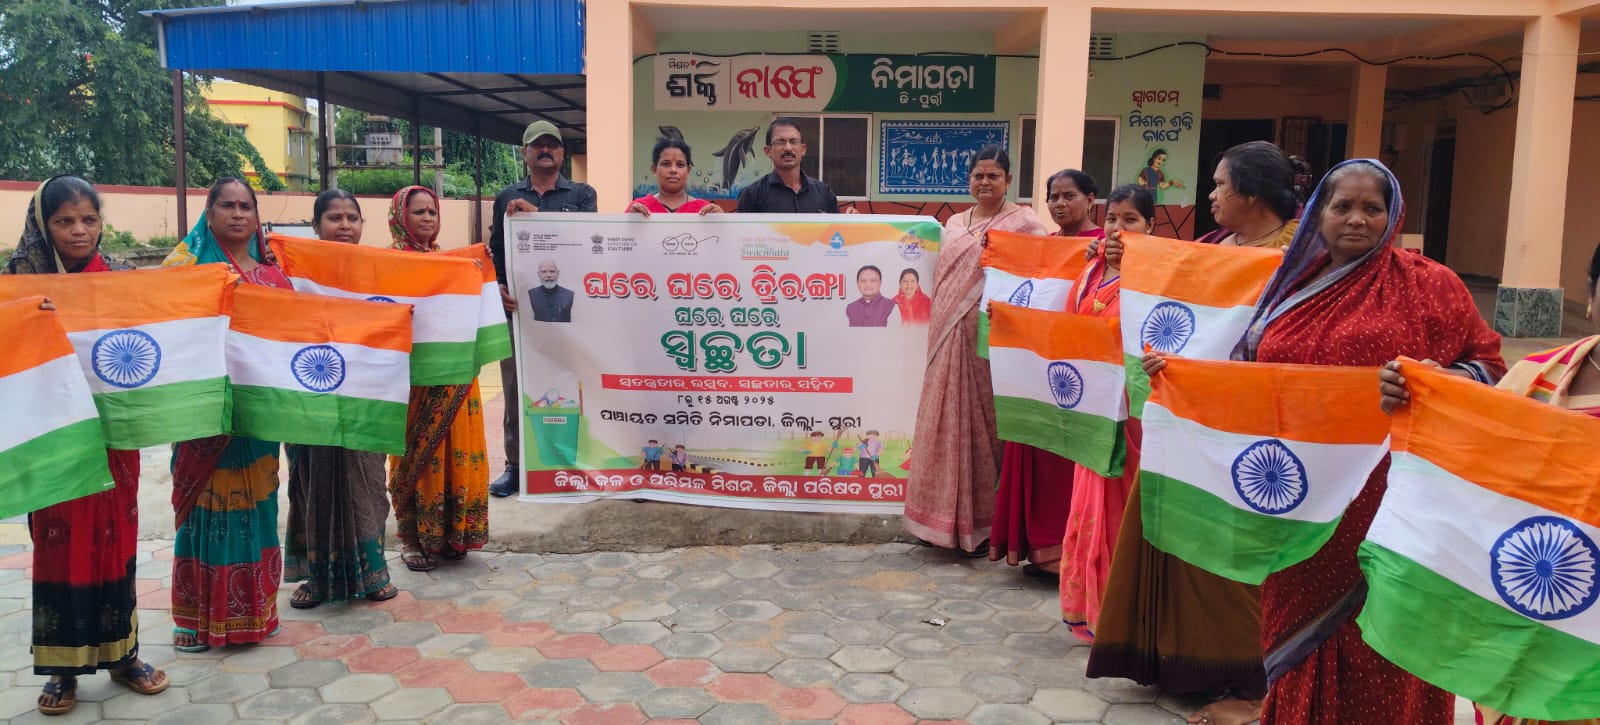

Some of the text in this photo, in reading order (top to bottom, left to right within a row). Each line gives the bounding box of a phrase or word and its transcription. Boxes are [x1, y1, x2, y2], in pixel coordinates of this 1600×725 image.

[668, 58, 690, 69] ମିଶନ
[736, 65, 823, 99] କାଫେ
[871, 57, 974, 93] ନିମାପଡ଼ା
[899, 91, 909, 104] ଜି
[919, 91, 942, 108] ପୁରୀ
[1132, 90, 1180, 109] ସ୍ୱାଗତମ୍
[1129, 110, 1193, 130] ମିଶନ ଶକ୍ତି
[583, 264, 846, 304] ଘରେ ଘରେ ତ୍ରିରଙ୍ଗା
[674, 306, 779, 327] ଘରେ ଘରେ
[660, 330, 806, 372] ସ୍ୱଚ୍ଛତା
[797, 377, 835, 391] ସହିତ
[697, 395, 712, 405] ୧୫
[744, 396, 774, 405] ୨୦୨୫
[600, 409, 657, 424] ପଞ୍ଚାୟତ
[663, 410, 703, 425] ସମିତି
[828, 416, 862, 431] ପୁରୀ
[554, 471, 589, 490] ଜିଲ୍ଲା
[630, 474, 644, 486] ଓ
[649, 472, 706, 489] ପରିମଳ
[762, 477, 798, 497] ଜିଲ୍ଲା
[803, 478, 862, 495] ପରିଷଦ
[868, 483, 903, 499] ପୁରୀ
